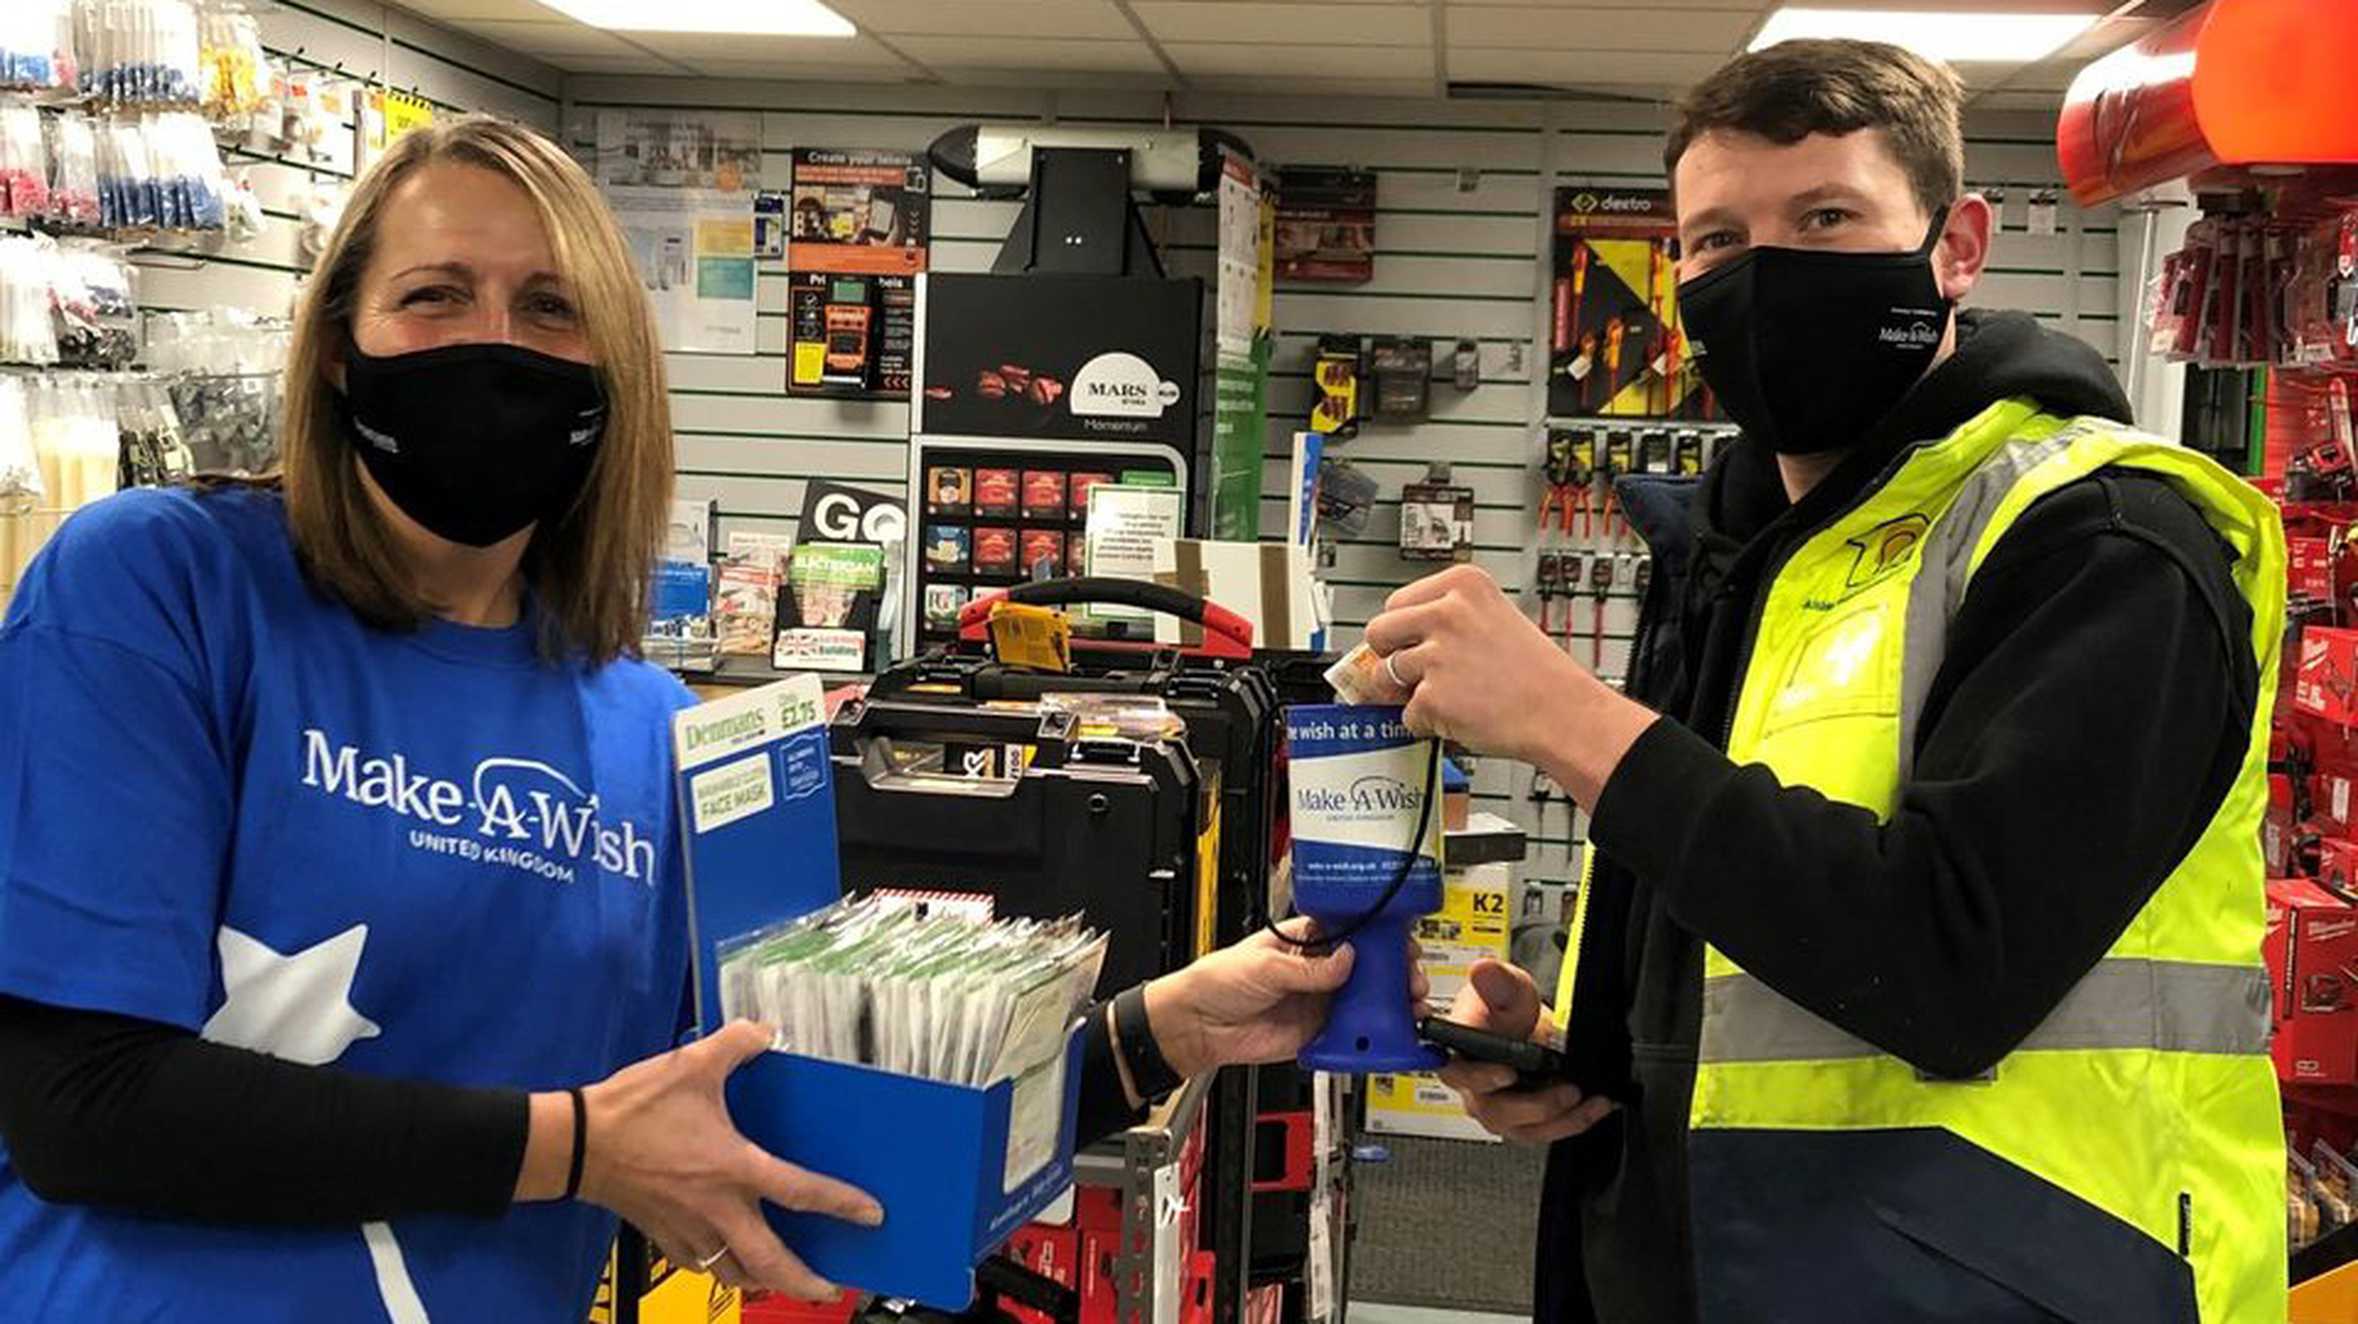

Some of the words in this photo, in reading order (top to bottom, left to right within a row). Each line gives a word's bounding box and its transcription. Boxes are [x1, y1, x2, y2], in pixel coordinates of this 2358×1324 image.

[808, 151, 846, 164] Create
[1088, 383, 1147, 397] MARS
[685, 707, 765, 750] Denmans
[780, 700, 817, 729] £2.75
[1300, 721, 1335, 740] wish
[1339, 722, 1358, 739] at
[1364, 724, 1375, 739] a
[302, 729, 656, 887] Make-A-Wish
[701, 793, 732, 817] FACE
[734, 783, 766, 806] MASK
[409, 829, 481, 861] UNITED
[484, 847, 576, 884] KINGDOM
[1473, 893, 1504, 914] K2
